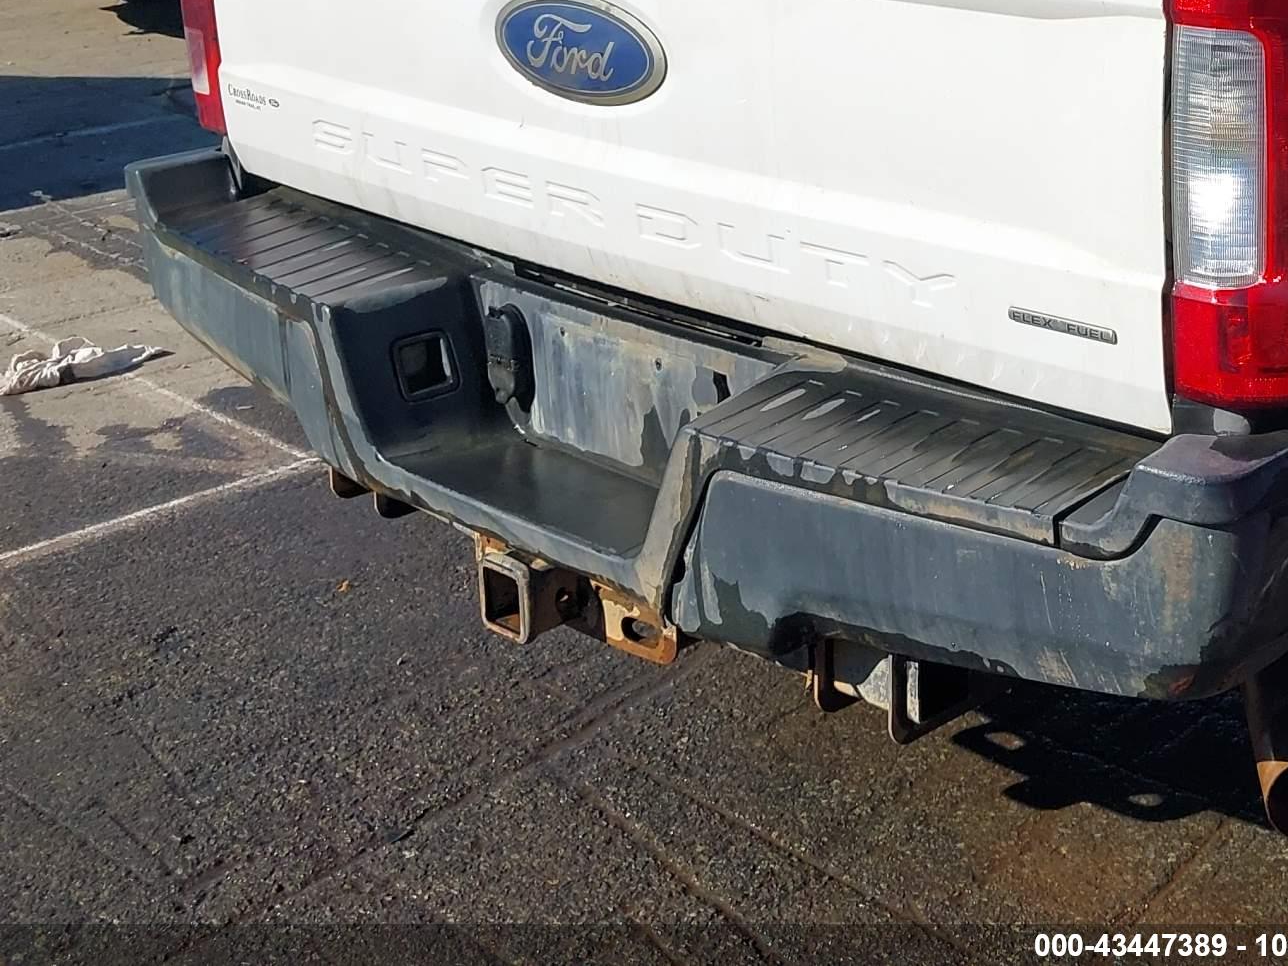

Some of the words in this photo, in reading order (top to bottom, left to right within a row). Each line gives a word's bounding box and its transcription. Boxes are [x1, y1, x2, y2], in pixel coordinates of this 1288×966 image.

[527, 13, 615, 82] Ford
[311, 119, 606, 230] SUPER
[634, 201, 958, 309] DUTY
[1012, 311, 1054, 330] FLEX
[1066, 323, 1114, 344] FUEL
